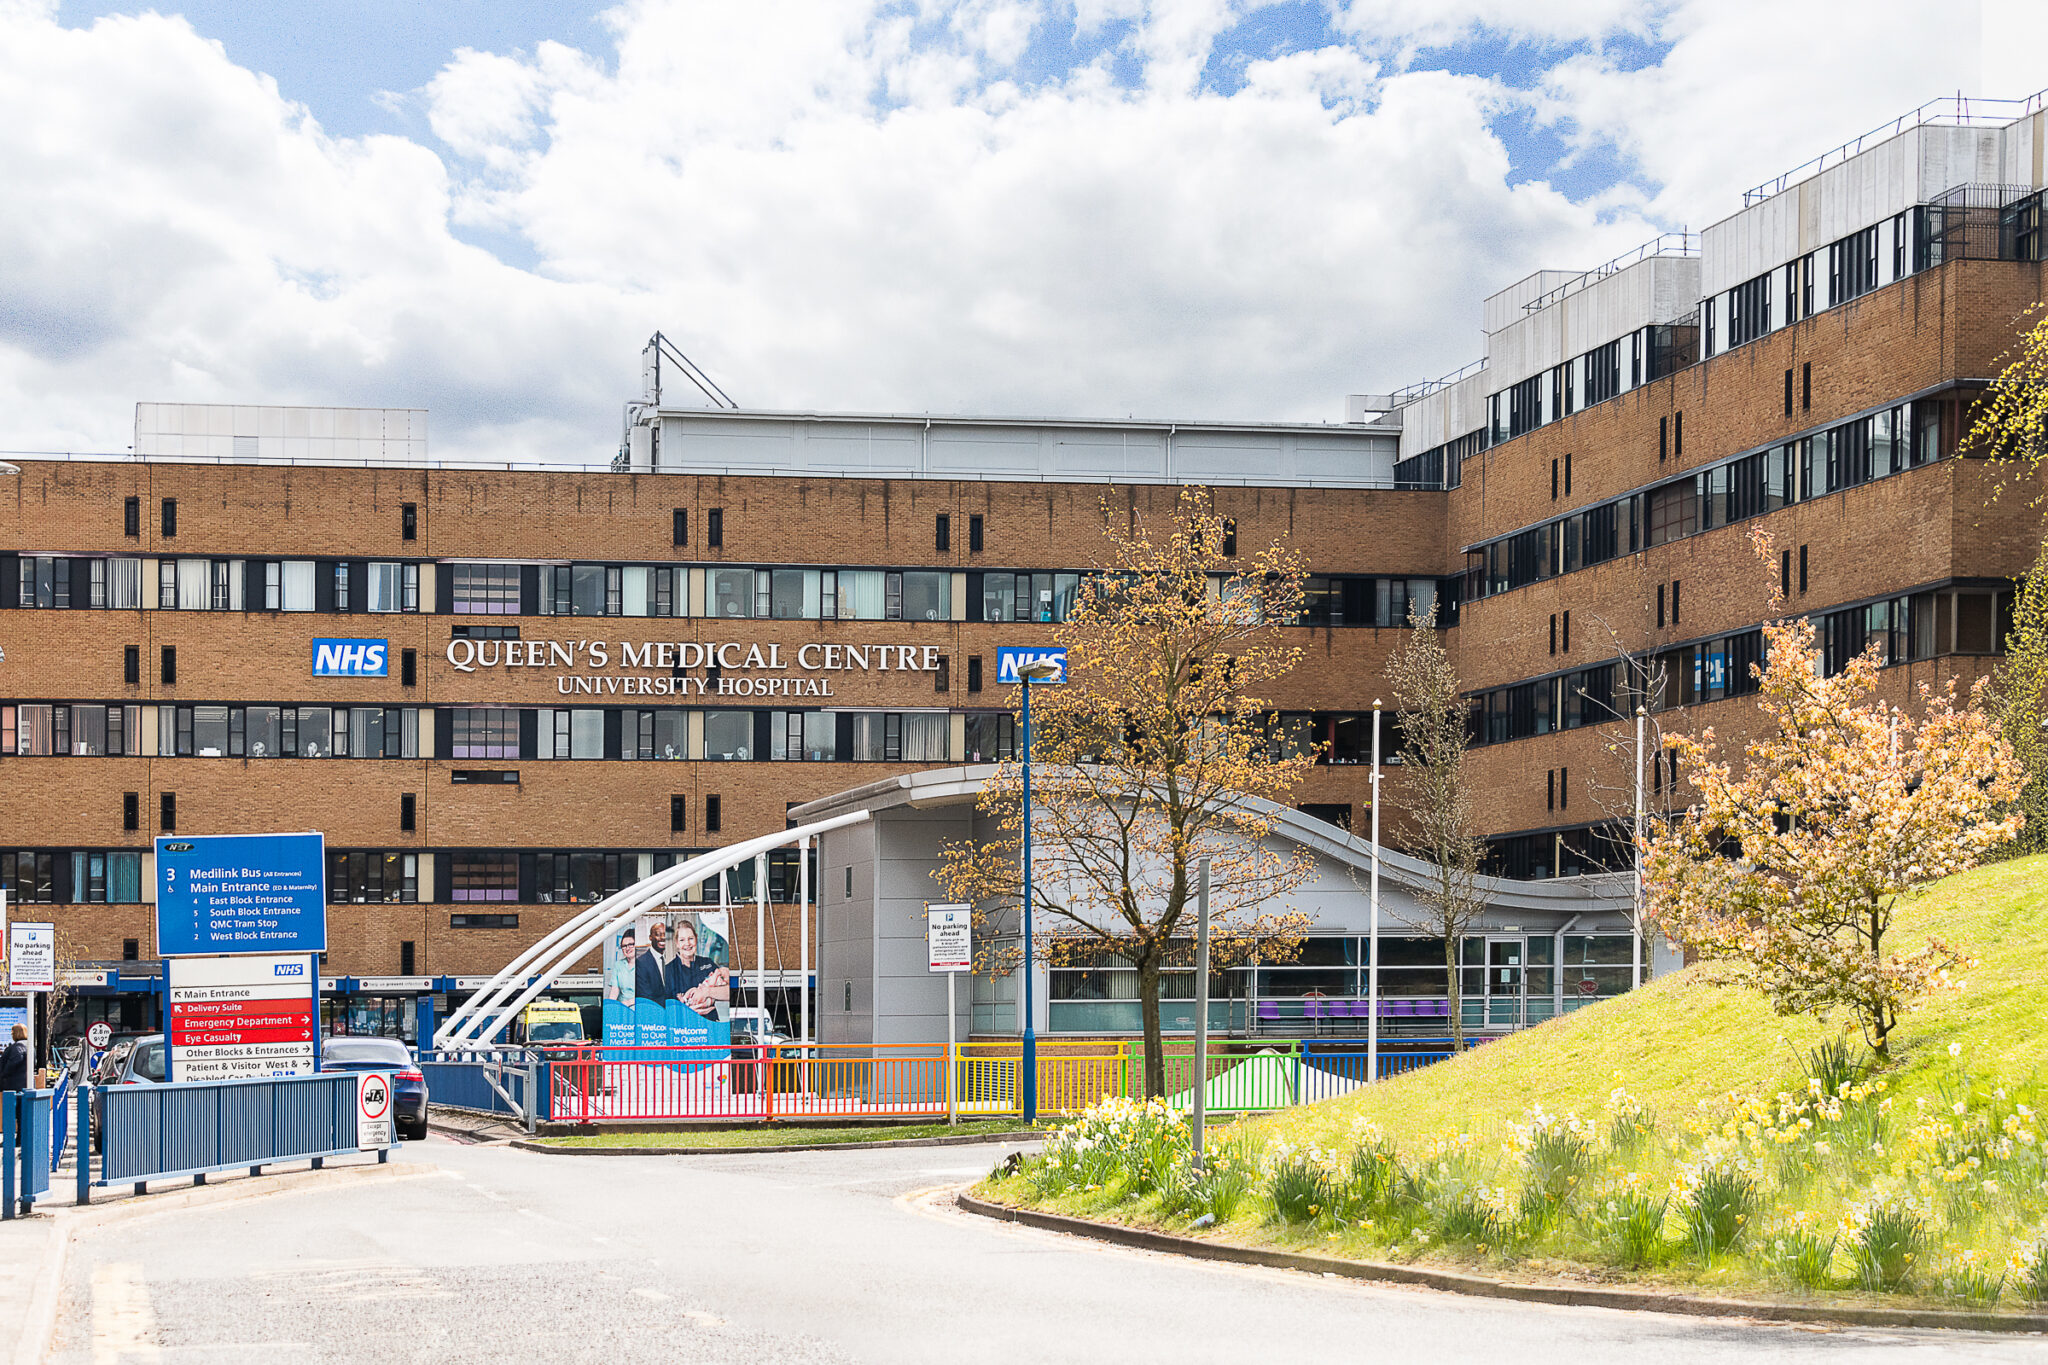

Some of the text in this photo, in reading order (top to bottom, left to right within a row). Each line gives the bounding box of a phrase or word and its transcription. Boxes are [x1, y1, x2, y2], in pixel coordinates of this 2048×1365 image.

[315, 644, 385, 671] NHS
[446, 639, 941, 673] QUEEN'S MEDICAL CENTRE
[557, 675, 834, 697] UNIVERSITY HOSPITAL
[166, 868, 176, 881] 3
[190, 868, 239, 879] Medilink
[241, 868, 262, 878] Bus
[274, 870, 302, 878] Entrances)
[190, 883, 219, 893] Main
[221, 882, 270, 892] Entrance
[289, 884, 318, 892] Maternity)
[209, 896, 228, 905] East
[230, 896, 253, 904] Block
[255, 895, 293, 904] Entrance
[210, 908, 236, 917] South
[238, 907, 261, 916] Block
[263, 907, 301, 915] Entrance
[210, 920, 232, 930] QMC
[234, 919, 256, 928] Tram
[257, 919, 278, 929] Stop
[942, 923, 968, 931] parking
[210, 932, 233, 941] West
[235, 931, 258, 940] Block
[260, 931, 298, 939] Entrance
[25, 942, 51, 950] parking
[276, 964, 302, 975] NHS
[184, 988, 250, 999] Main Entrance
[187, 1003, 243, 1013] Delivery Suite
[184, 1016, 293, 1029] Emergency Department
[185, 1032, 242, 1044] Eye Casualty
[609, 1038, 635, 1046] Medical
[186, 1049, 213, 1058] Other
[215, 1047, 244, 1057] Blocks
[255, 1046, 299, 1055] Entrances
[186, 1063, 219, 1072] Patient
[231, 1061, 261, 1070] Visitor
[265, 1060, 289, 1069] West
[291, 1060, 298, 1068] &
